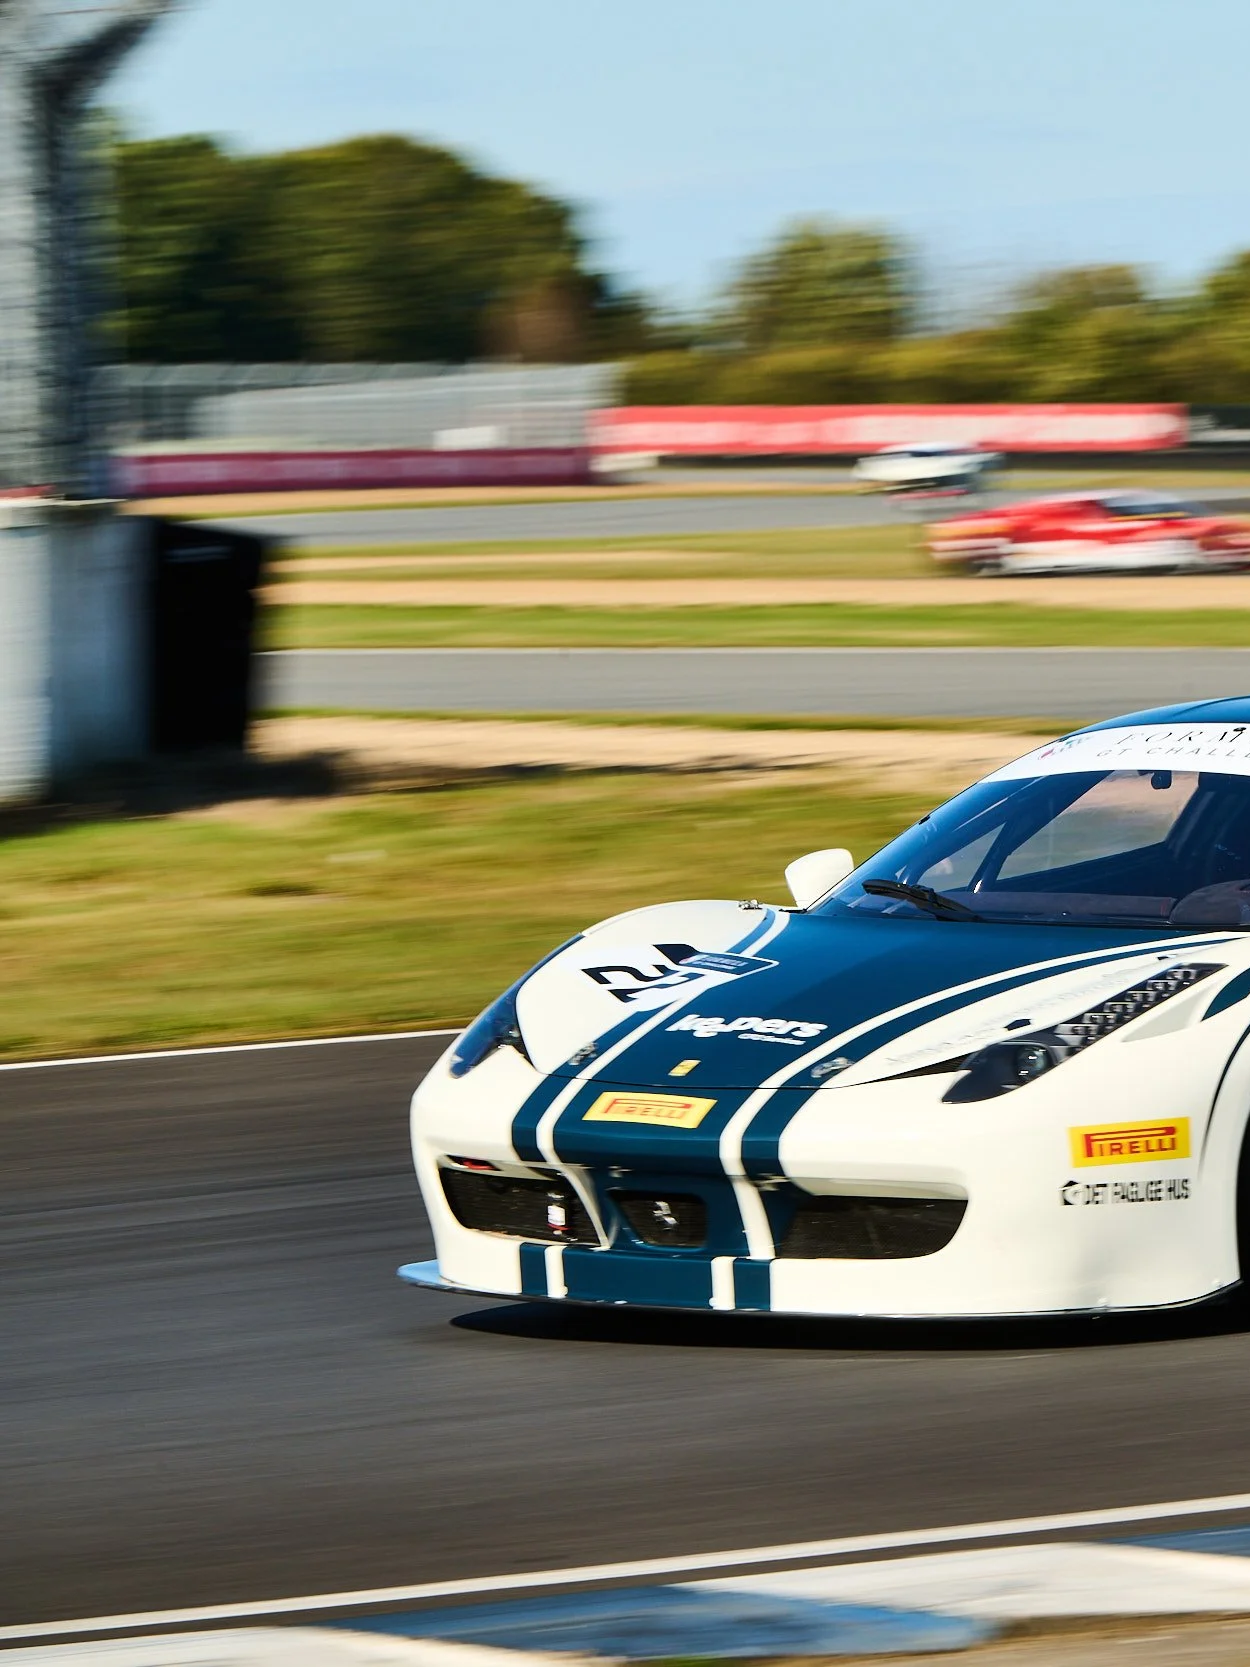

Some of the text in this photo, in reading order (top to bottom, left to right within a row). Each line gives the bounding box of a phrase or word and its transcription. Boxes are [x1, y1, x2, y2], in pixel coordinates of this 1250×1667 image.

[1096, 747, 1132, 758] GT
[604, 1098, 692, 1120] PIRELLI
[1084, 1126, 1177, 1158] PIRELLI
